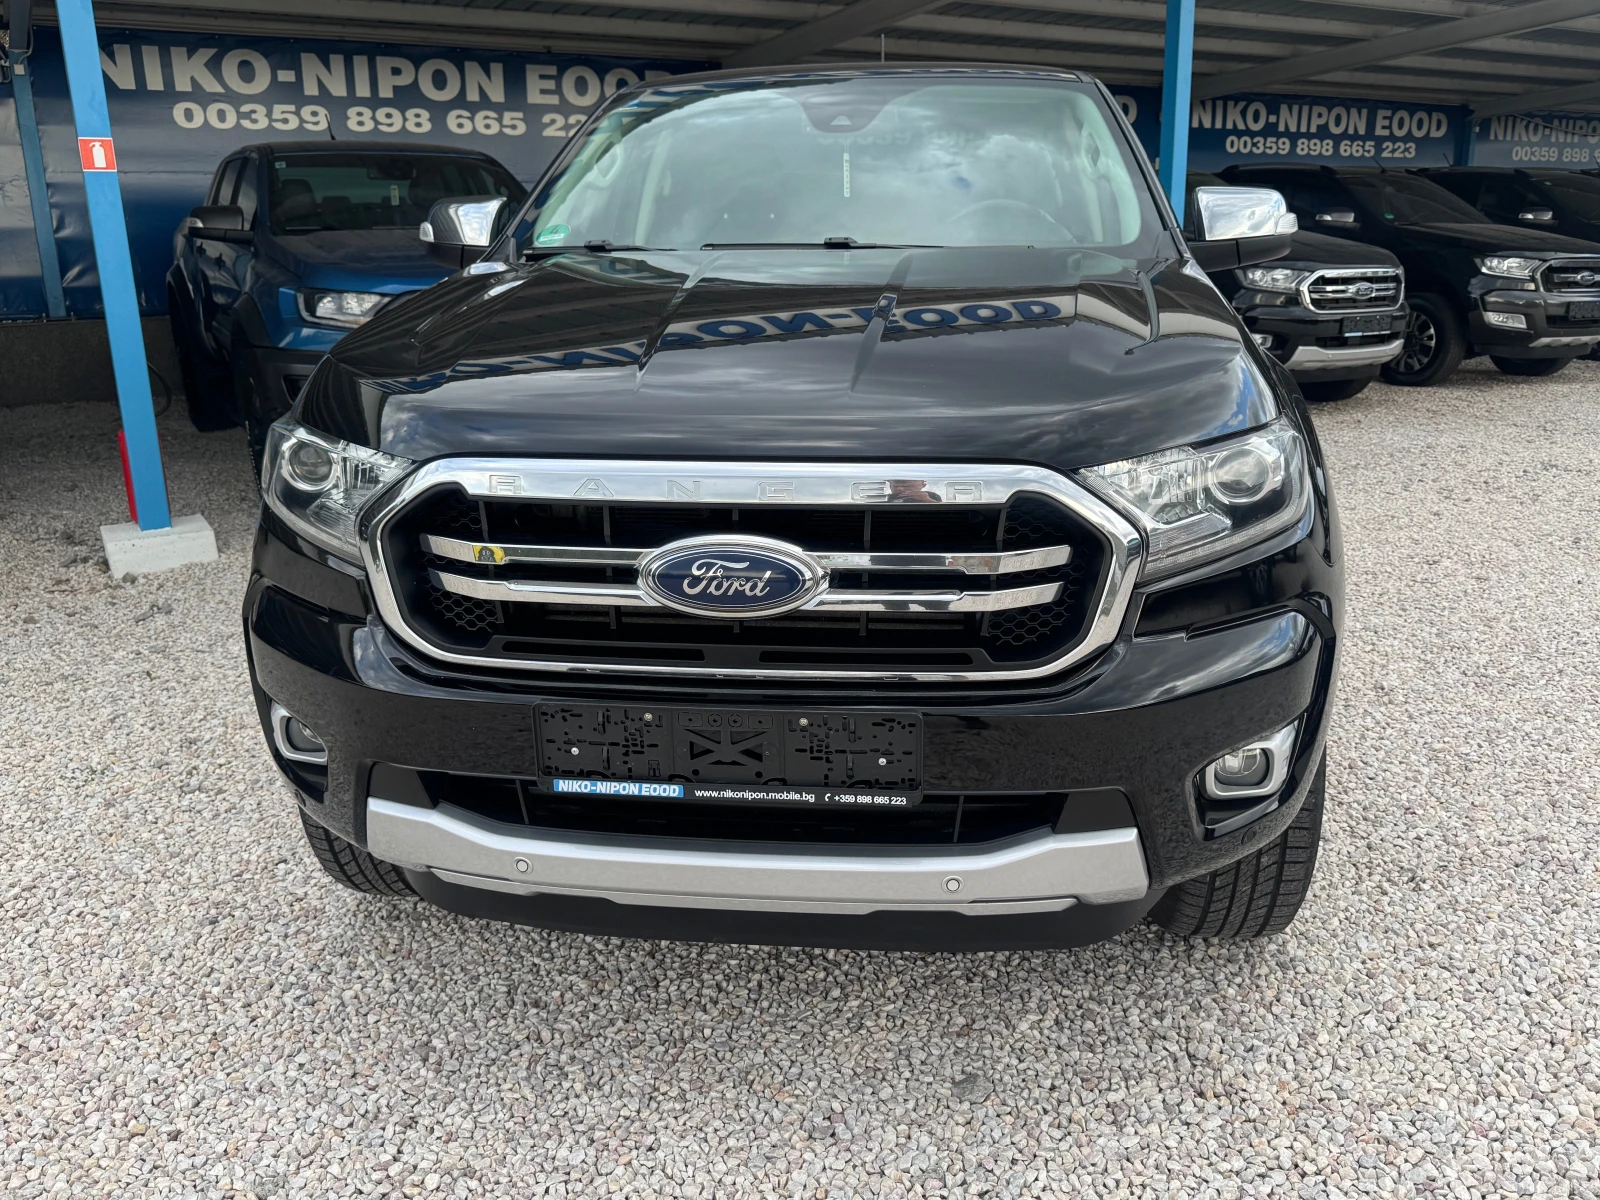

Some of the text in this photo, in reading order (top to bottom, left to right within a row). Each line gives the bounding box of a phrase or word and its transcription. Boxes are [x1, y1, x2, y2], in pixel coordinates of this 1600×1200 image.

[525, 64, 677, 107] EOO
[172, 101, 330, 131] 00359
[346, 106, 432, 133] 898
[446, 109, 527, 136] 665
[1191, 99, 1449, 138] NIKO-NIPON EOOD
[1225, 135, 1416, 159] 00359 898 665 223
[1512, 146, 1558, 161] 00359
[1562, 148, 1589, 162] 898
[488, 474, 983, 503] RANGER
[682, 558, 772, 597] Ford
[558, 779, 907, 806] NIKO-NIPON EOOD www.nikonipon.mobile.bg +359 898 665 223
